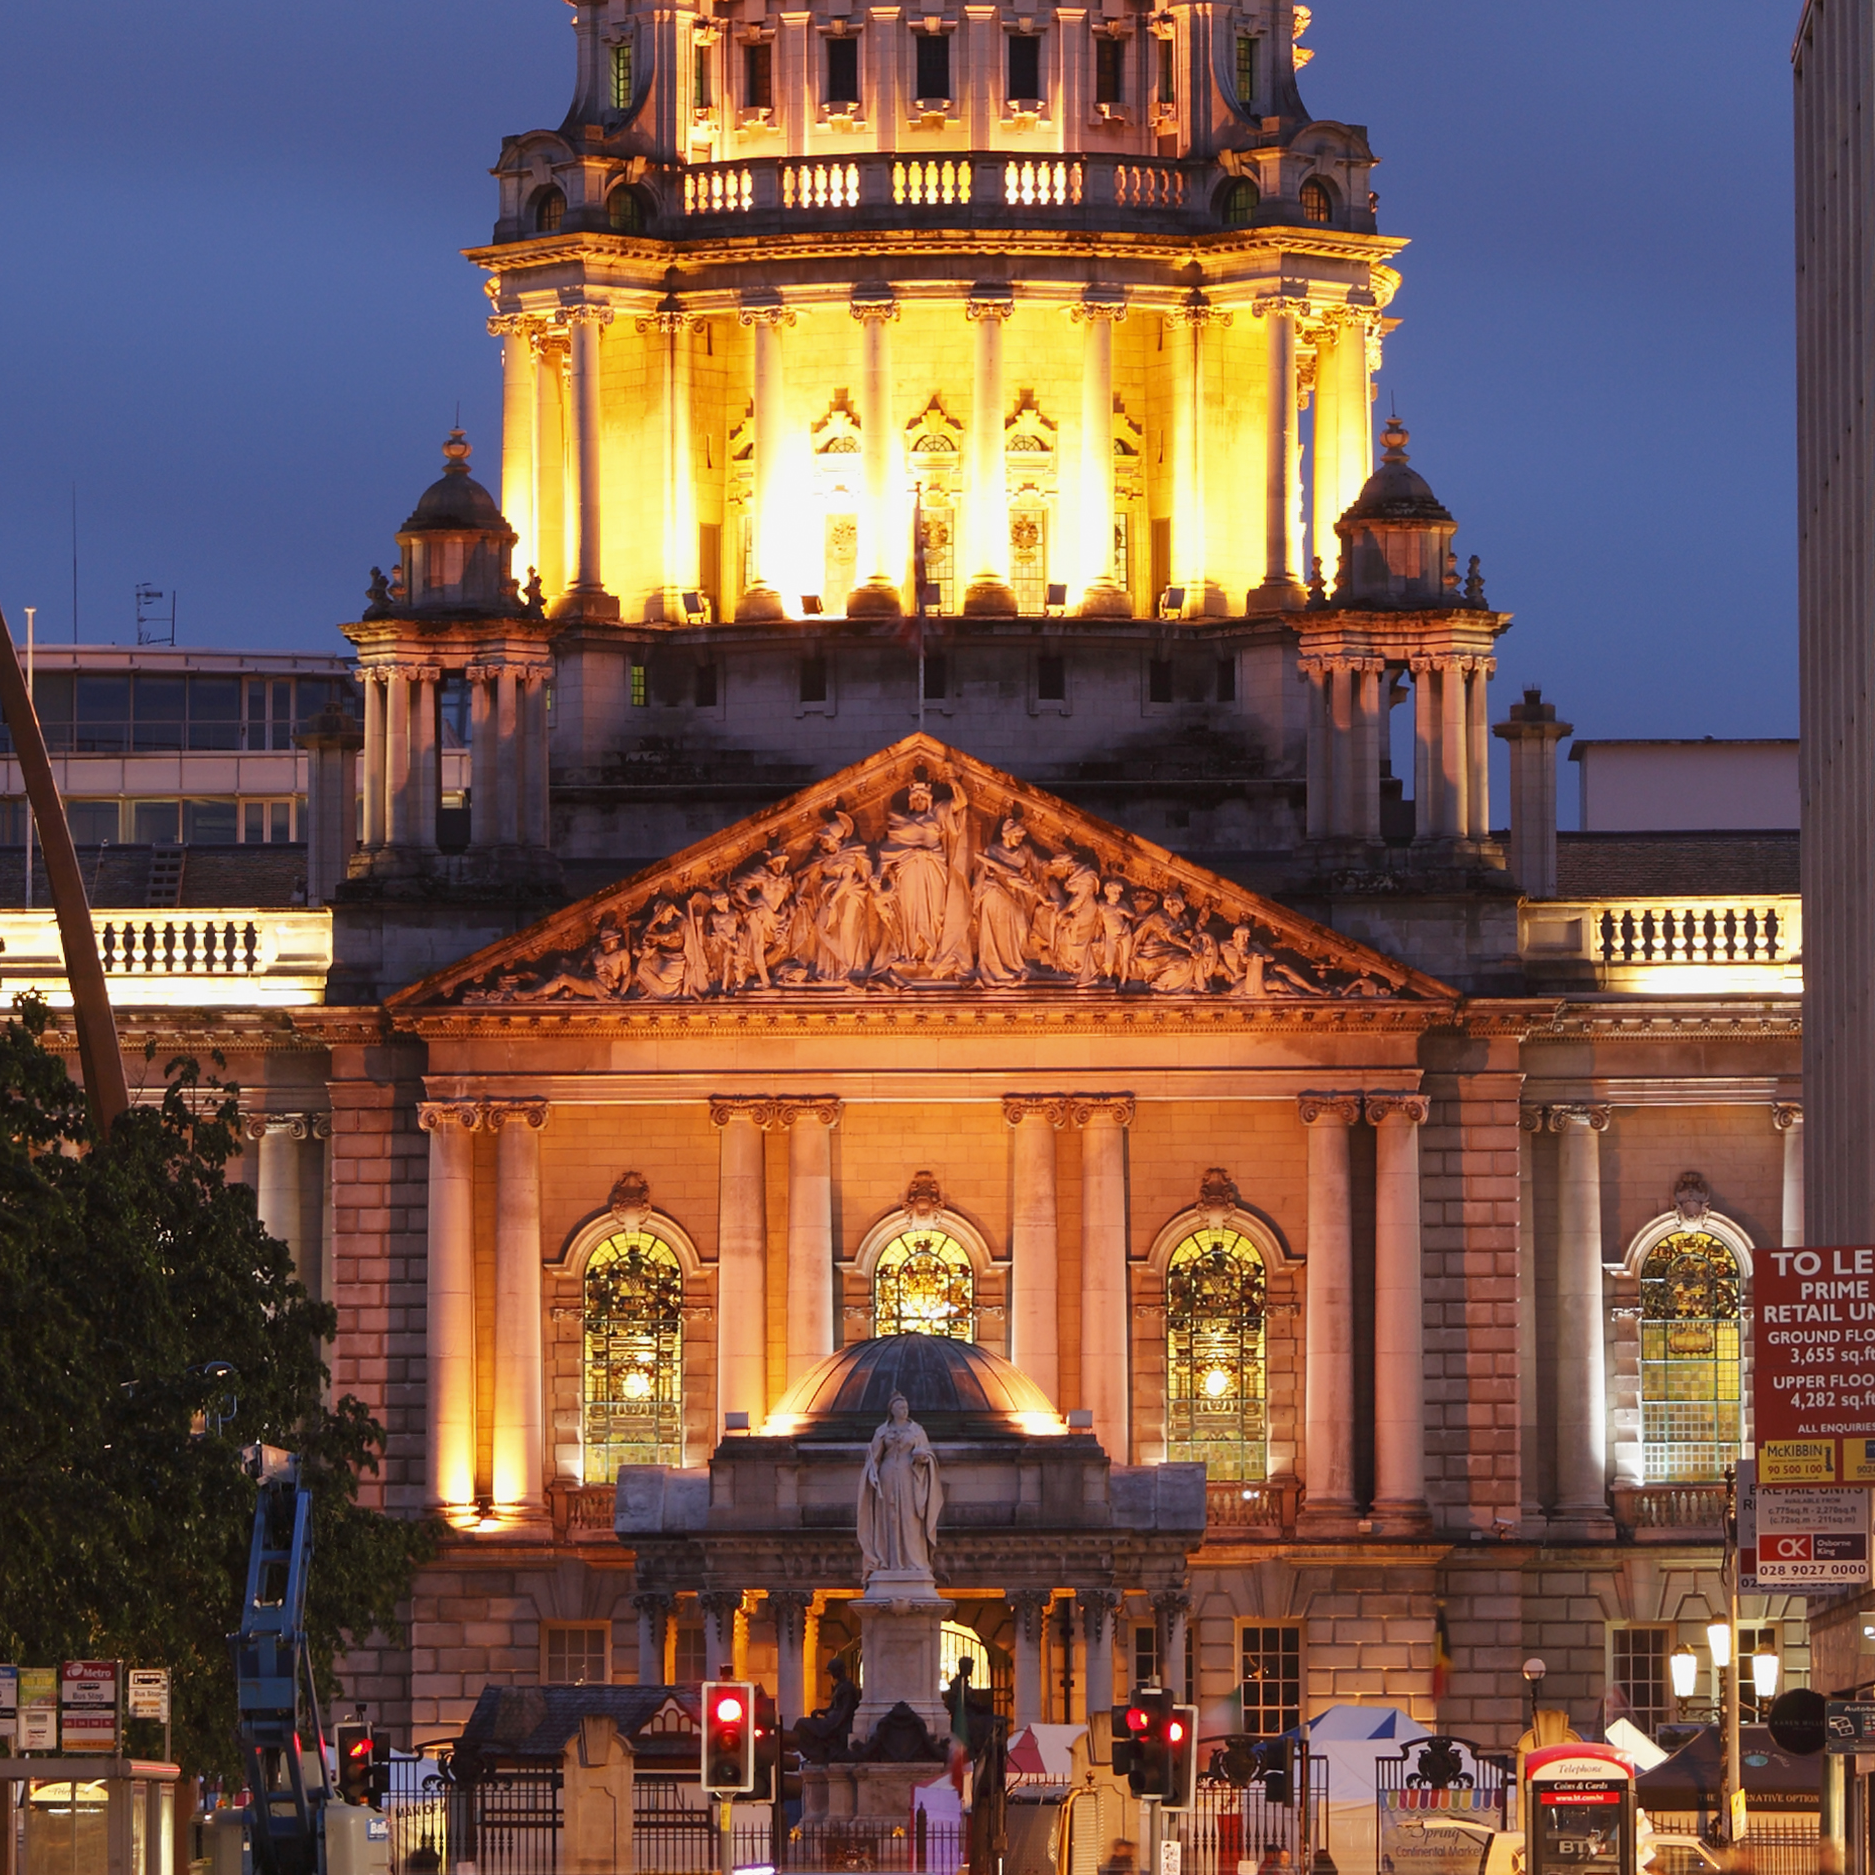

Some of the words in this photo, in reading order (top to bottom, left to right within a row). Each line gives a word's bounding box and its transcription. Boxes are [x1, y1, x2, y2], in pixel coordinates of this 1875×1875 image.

[1770, 1251, 1822, 1276] TO
[1801, 1280, 1870, 1300] PRIME
[1764, 1303, 1843, 1323] RETAIL
[1768, 1330, 1841, 1345] GROUND
[1790, 1346, 1835, 1366] 3,655
[1773, 1374, 1826, 1389] UPPER
[1790, 1391, 1835, 1410] 4,282
[1798, 1424, 1818, 1434] ALL
[1767, 1444, 1823, 1458] McKIBBIN
[1768, 1465, 1780, 1475] 90
[1783, 1464, 1801, 1474] 500
[1806, 1464, 1822, 1474] 100
[1817, 1539, 1851, 1547] Osborne
[1817, 1548, 1836, 1556] King
[1760, 1565, 1786, 1576] 028
[1791, 1565, 1826, 1575] 9027
[1831, 1564, 1866, 1575] 0000
[83, 1668, 112, 1679] Metro
[72, 1692, 86, 1700] Bus
[88, 1692, 104, 1701] Stop
[1558, 1764, 1603, 1775] Telephone
[1554, 1781, 1575, 1790] Coins
[1585, 1781, 1608, 1790] Cards
[1785, 1793, 1819, 1803] OPTION
[1395, 1845, 1445, 1858] Continental
[1448, 1845, 1484, 1857] Market
[1559, 1840, 1586, 1854] BT
